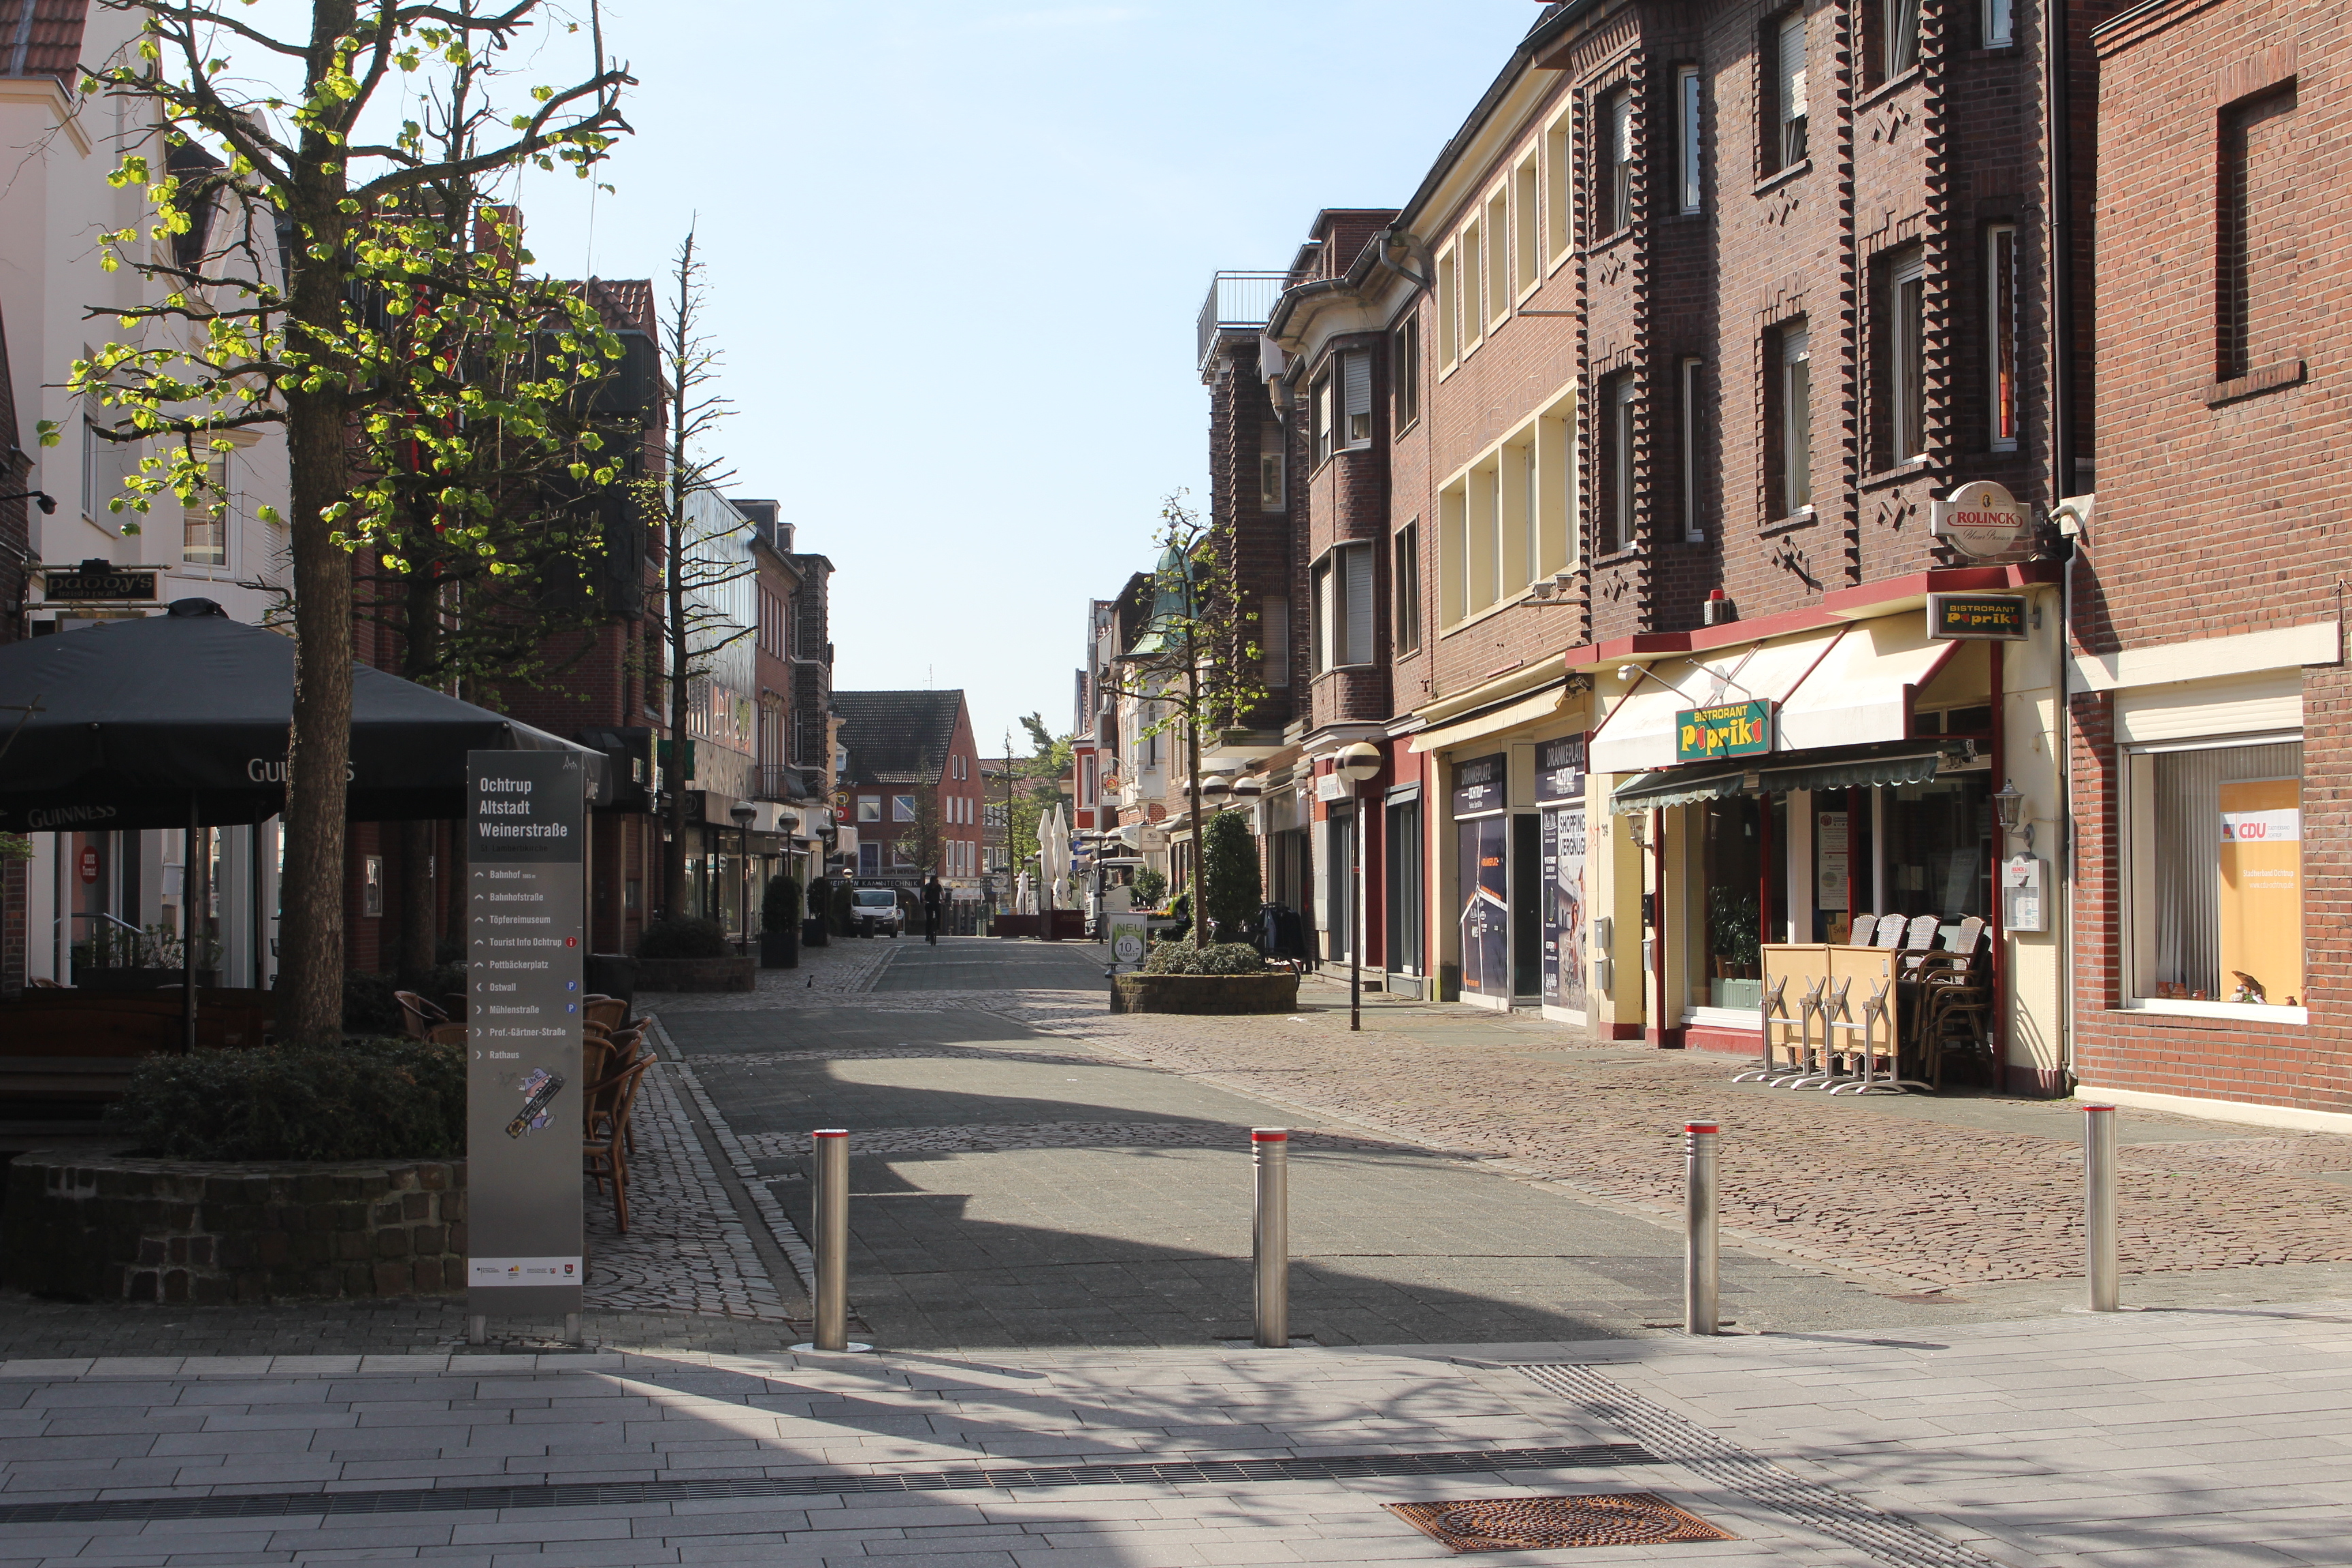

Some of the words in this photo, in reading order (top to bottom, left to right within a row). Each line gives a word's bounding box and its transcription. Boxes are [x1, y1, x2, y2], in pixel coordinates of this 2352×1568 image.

[1957, 512, 2016, 525] ROLINCK
[1987, 529, 2011, 540] Premium
[1694, 705, 1748, 722] BISTRORANT
[1556, 766, 1575, 785] OCHTRUP
[480, 778, 532, 794] Ochtrup
[480, 800, 530, 815] Altstadt
[28, 806, 116, 828] GUINNESS
[1560, 813, 1586, 834] SHOPPING
[479, 823, 568, 837] Weinerstraße
[2239, 822, 2266, 838] CDU
[490, 870, 520, 879] Bahnhof
[2243, 869, 2273, 877] Stadtverband
[2274, 869, 2294, 878] Ochtrup
[2249, 881, 2294, 890] www.cdu-ochtrup.de
[490, 893, 544, 901] Bahnhofstraße
[490, 915, 551, 925] Töpfereimuseum
[1117, 923, 1143, 932] NEU
[490, 938, 515, 946] Tourist
[517, 938, 532, 946] Info
[533, 938, 562, 948] Ochtrup
[490, 960, 549, 970] Pottbäckerplatz
[490, 983, 516, 992] Ostwall
[490, 1005, 540, 1014] Mühlenstraße
[490, 1028, 566, 1036] Prof.-Gärtner-Straße
[490, 1050, 519, 1059] Rathaus
